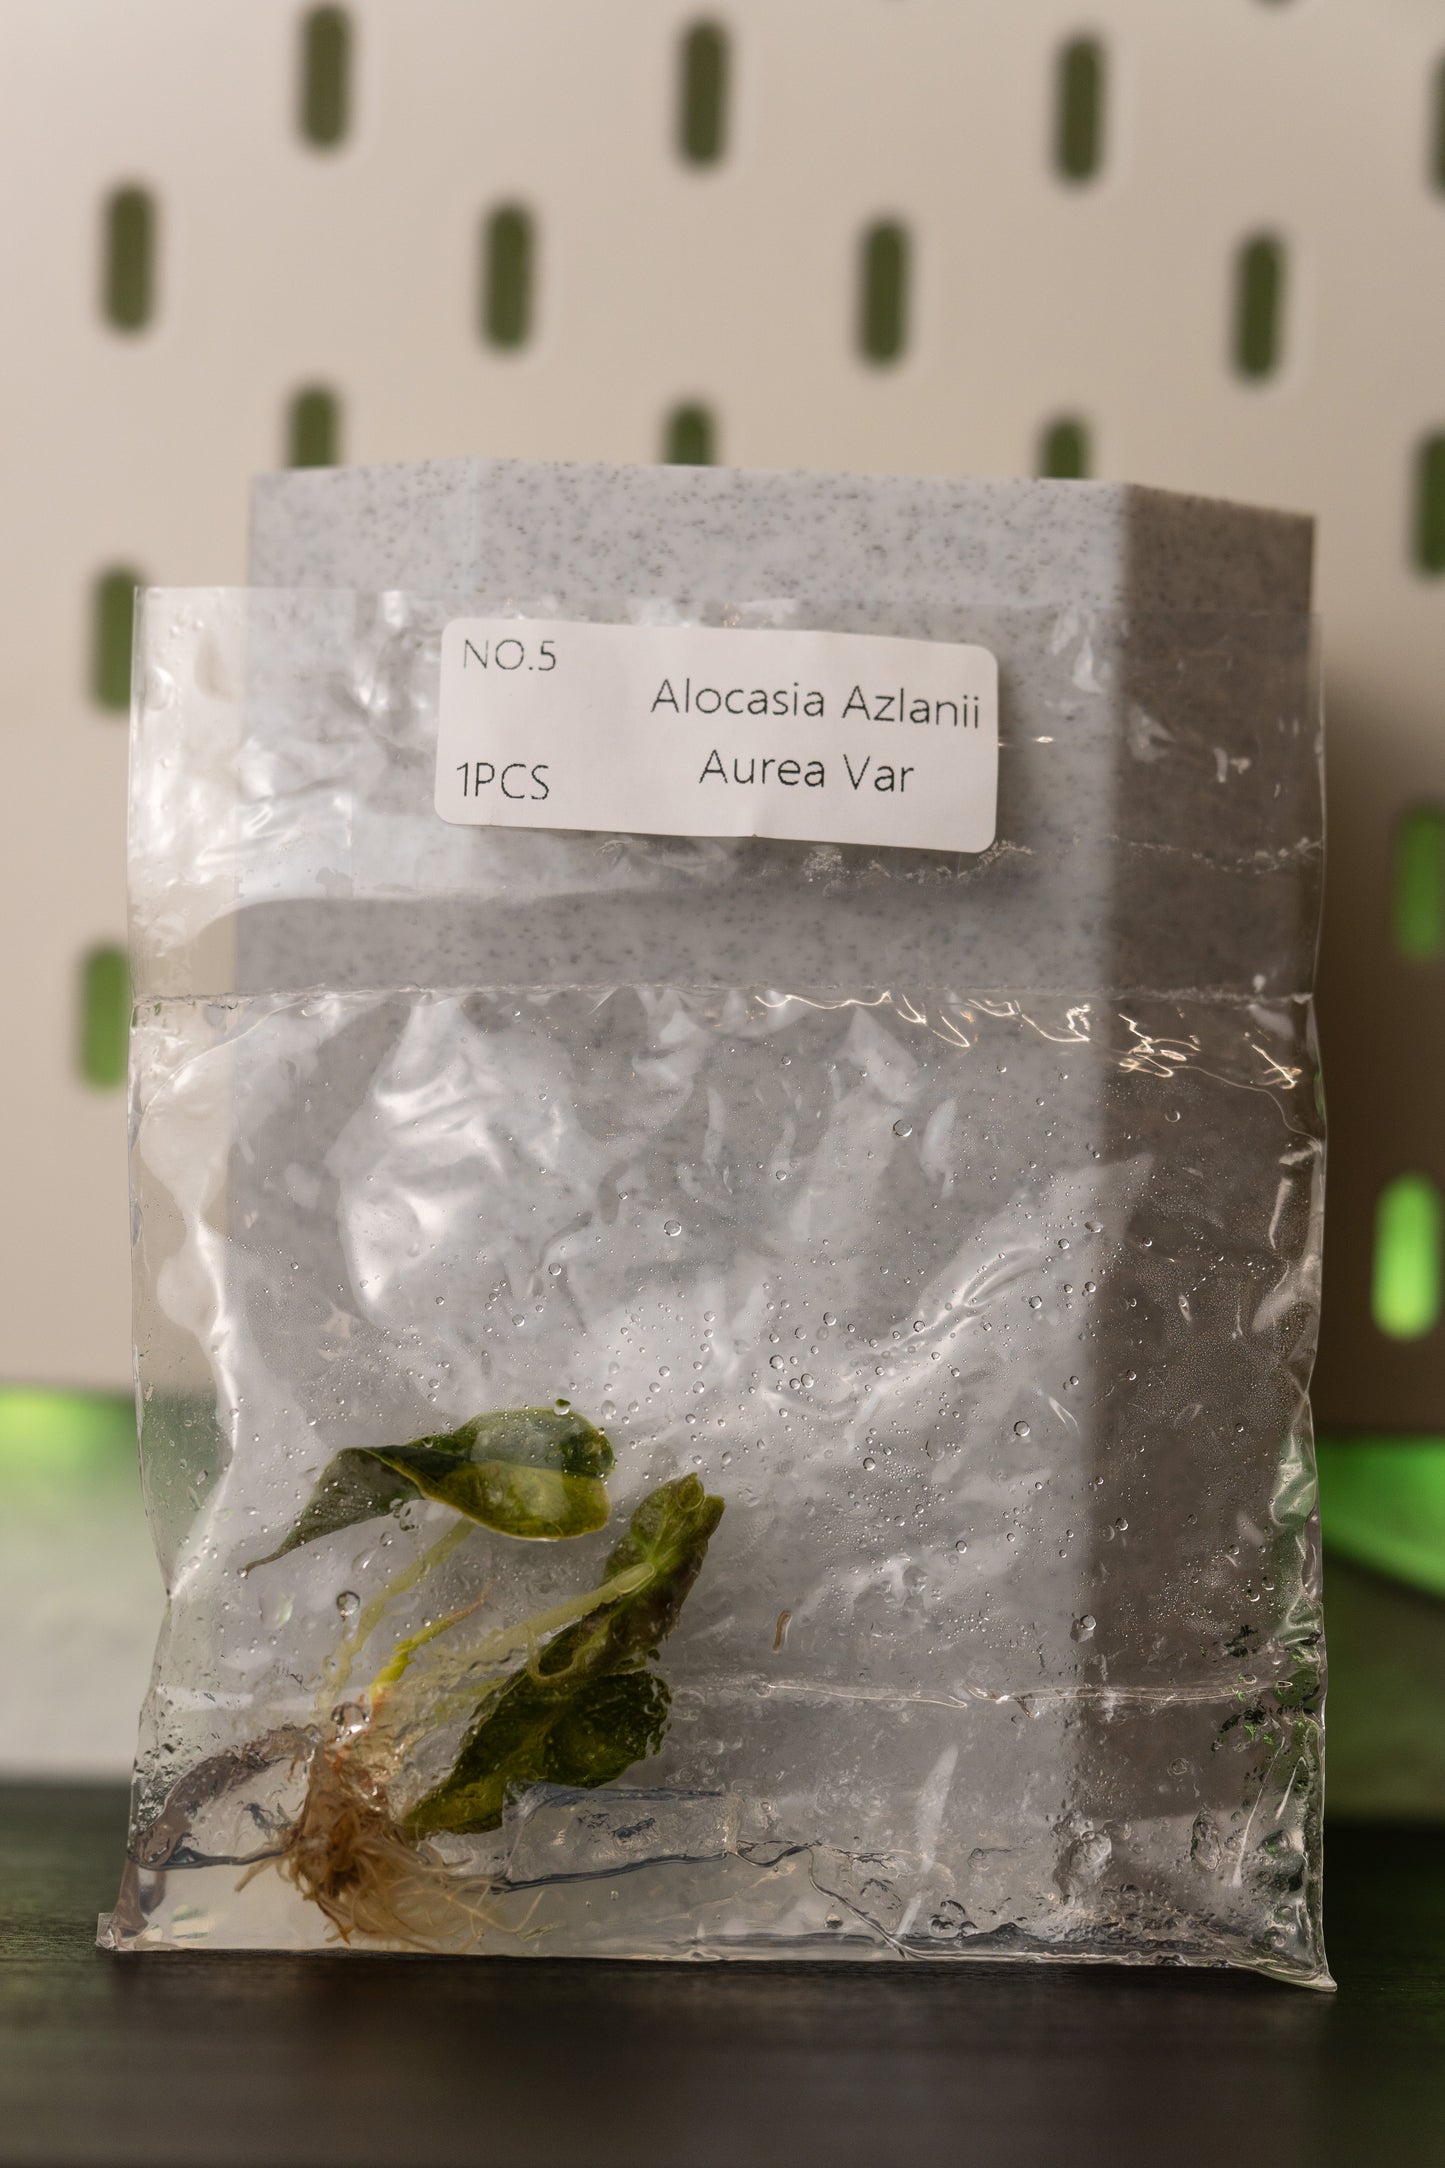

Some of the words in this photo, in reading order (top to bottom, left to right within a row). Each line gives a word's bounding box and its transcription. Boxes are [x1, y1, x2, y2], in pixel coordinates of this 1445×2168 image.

[463, 638, 557, 672] NO.5
[650, 677, 825, 718] Alocasia
[841, 684, 980, 729] Azlanii
[456, 761, 550, 801] 1PCS
[698, 748, 826, 789] Aurea
[842, 753, 915, 793] Var
